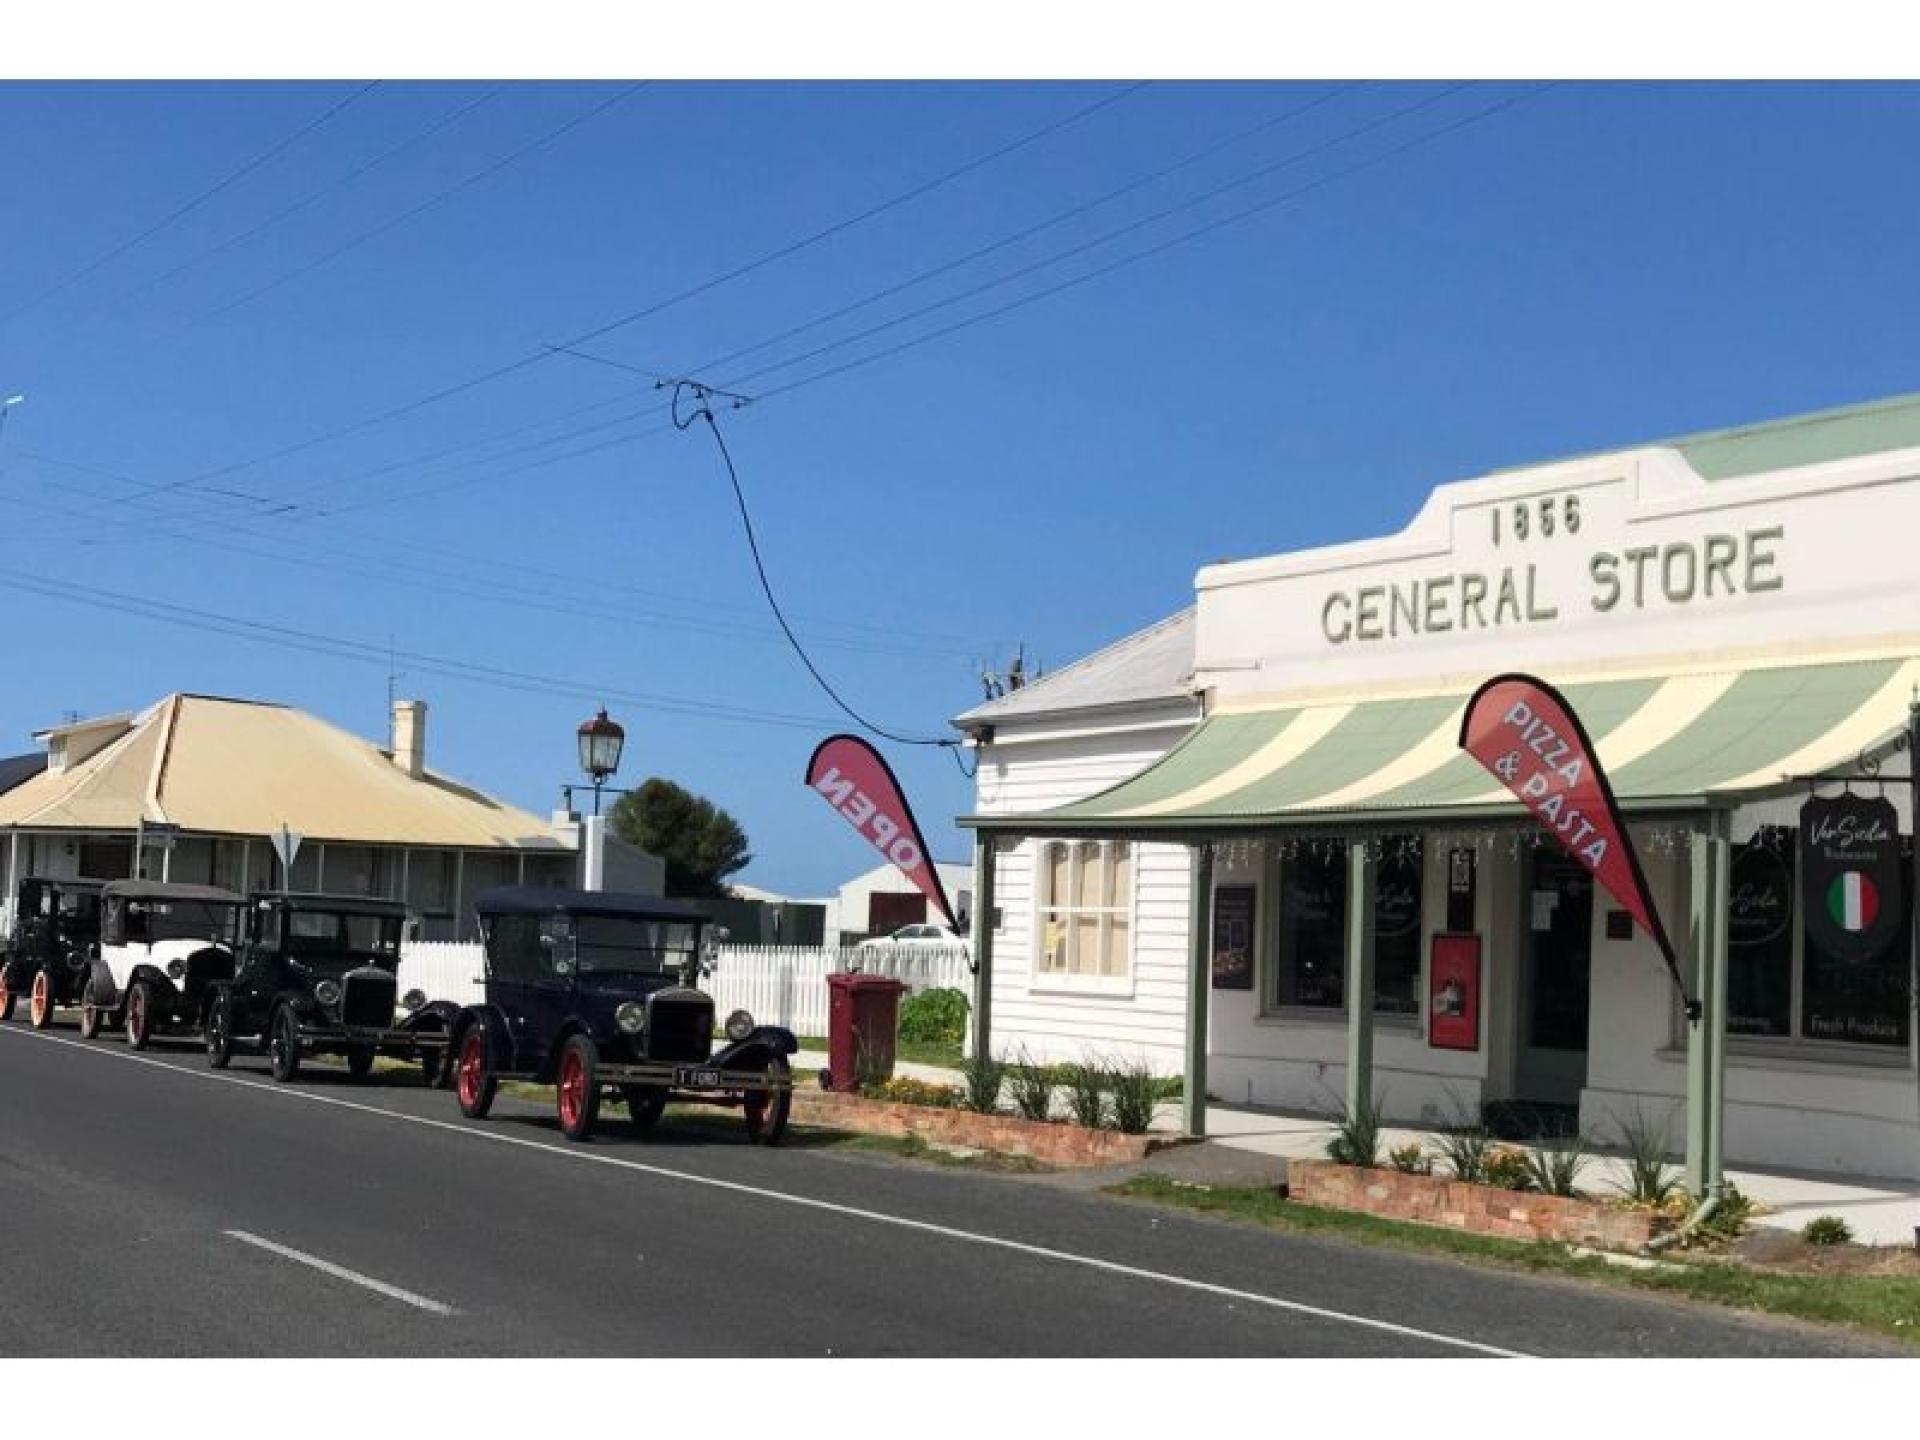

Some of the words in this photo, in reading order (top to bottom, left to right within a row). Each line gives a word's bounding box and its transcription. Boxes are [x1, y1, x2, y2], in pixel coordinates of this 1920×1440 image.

[1491, 494, 1582, 547] 1856
[1321, 563, 1558, 644] GENERAL
[1589, 525, 1784, 613] STORE
[1504, 700, 1583, 788] PIZZA
[1494, 751, 1521, 781] &
[1522, 772, 1608, 868] PASTA
